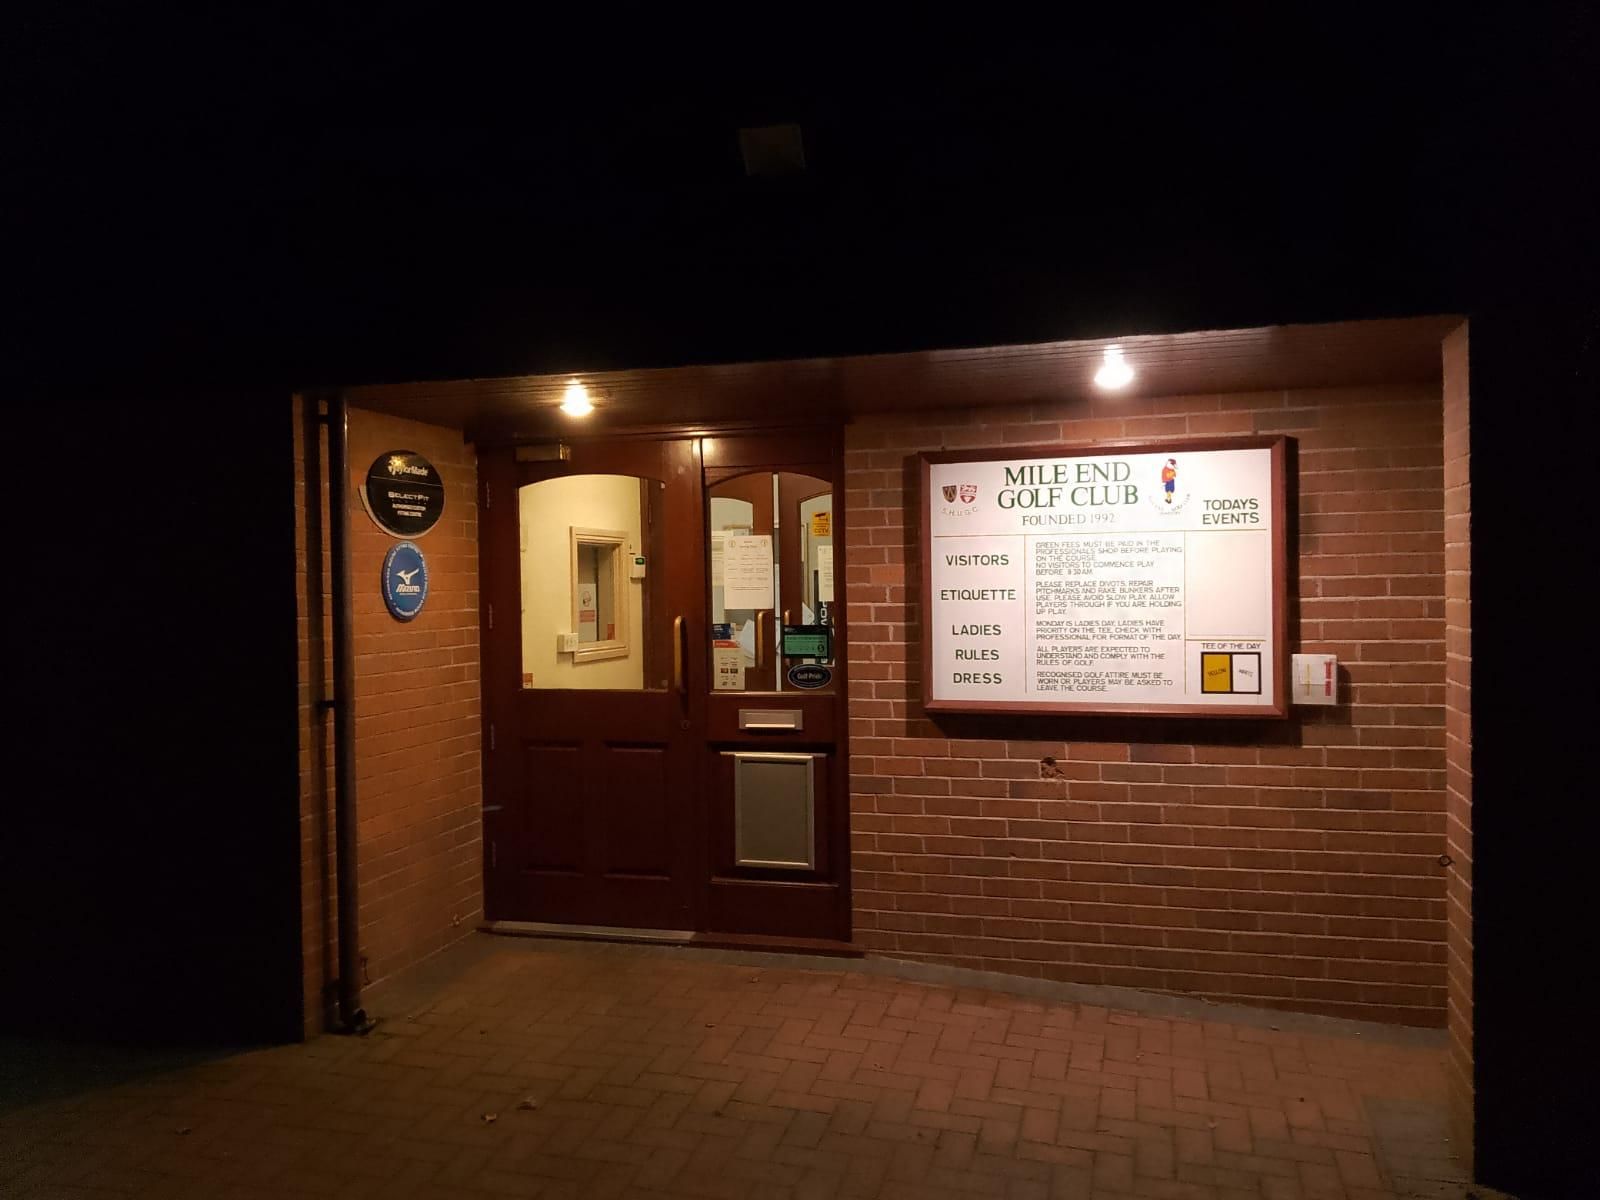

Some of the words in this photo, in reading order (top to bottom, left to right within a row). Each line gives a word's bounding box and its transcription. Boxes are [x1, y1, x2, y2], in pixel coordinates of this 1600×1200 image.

[1003, 464, 1069, 486] MILE
[1074, 461, 1131, 483] END
[997, 487, 1063, 509] GOLF
[1070, 485, 1139, 507] CLUB
[1203, 498, 1259, 511] TODAYS
[1022, 513, 1087, 526] FOUNDED
[1090, 512, 1115, 524] 1992
[1202, 512, 1260, 525] EVENTS
[945, 554, 1009, 566] VISITORS
[940, 589, 1016, 601] ETIQUETTE
[952, 624, 1002, 636] LADIES
[955, 649, 1000, 661] RULES
[953, 672, 1002, 684] DRESS
